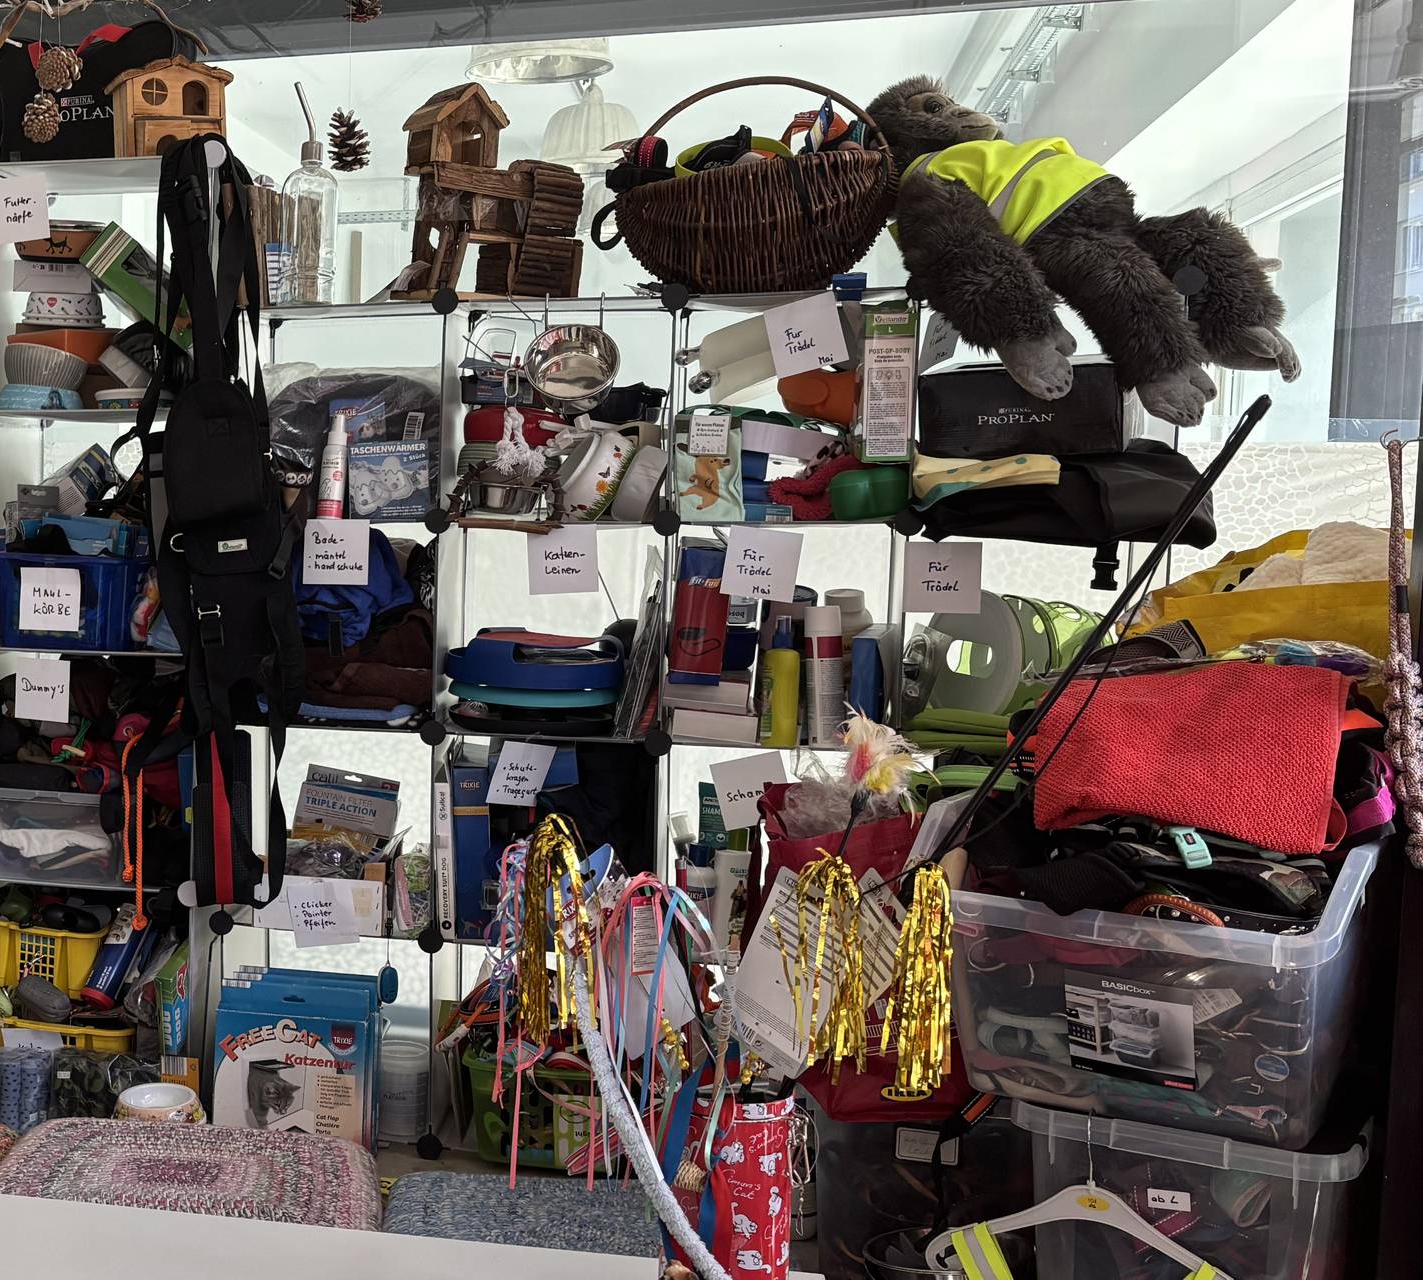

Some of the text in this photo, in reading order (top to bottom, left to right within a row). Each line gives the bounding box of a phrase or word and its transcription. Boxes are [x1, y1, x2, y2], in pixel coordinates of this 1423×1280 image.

[818, 353, 833, 364] Mai
[350, 443, 426, 455] TASCHENWÄRMER
[312, 531, 344, 544] Bade-
[743, 549, 765, 561] Für
[737, 565, 772, 576] Trödel
[929, 561, 950, 572] Für
[752, 584, 771, 595] Mai
[922, 580, 959, 592] Trödel
[306, 789, 346, 802] FOUNTAIN
[306, 796, 338, 809] TRIPLE
[339, 804, 377, 817] ACTION
[702, 807, 721, 815] SHAM
[285, 1054, 355, 1070] Katzentür
